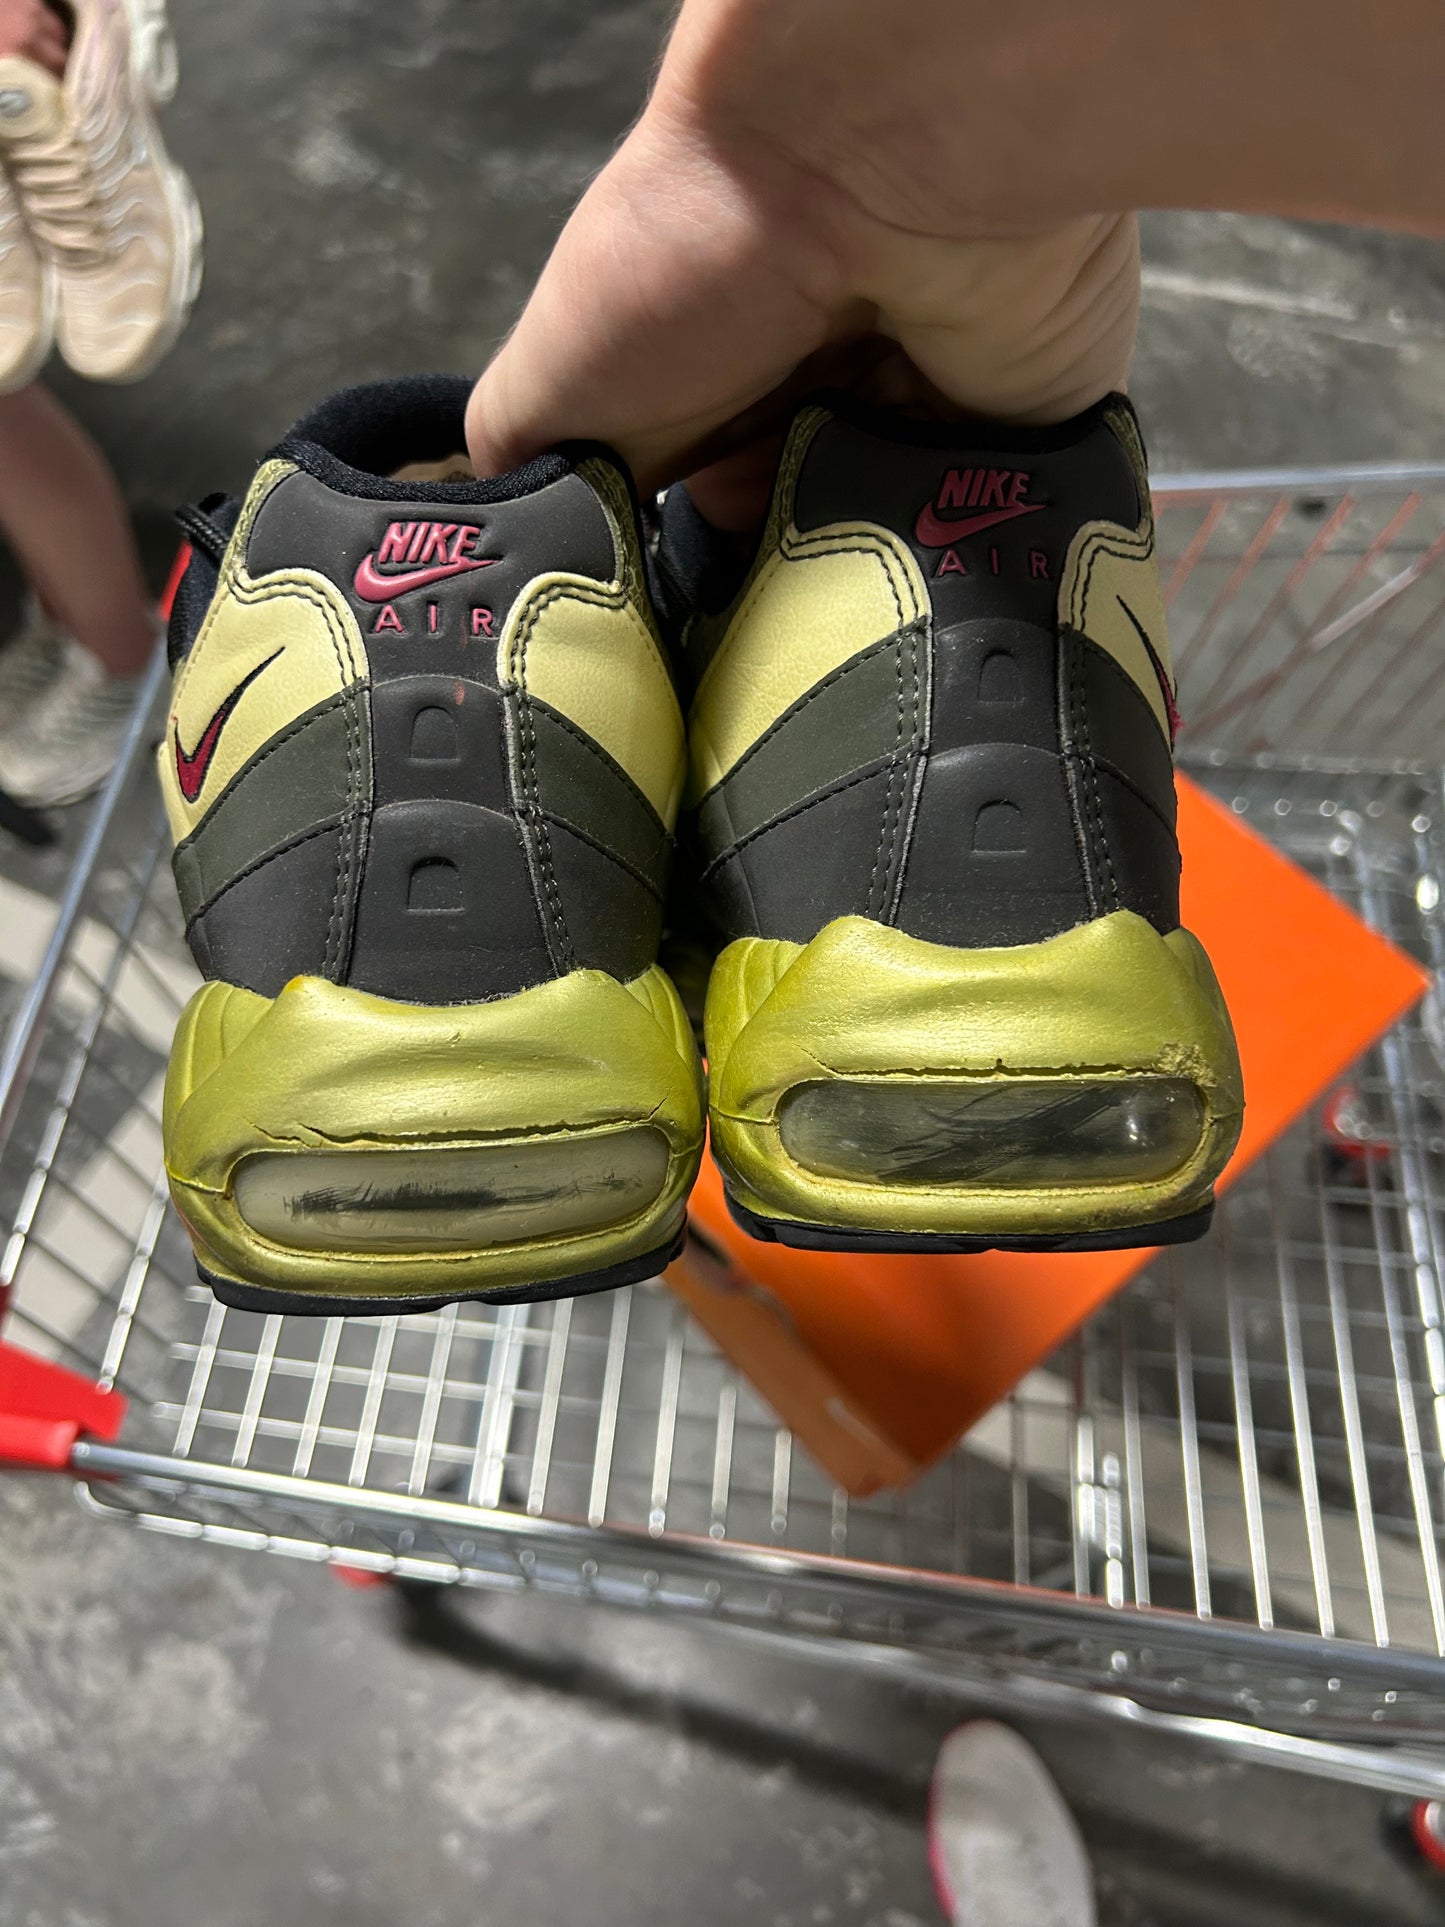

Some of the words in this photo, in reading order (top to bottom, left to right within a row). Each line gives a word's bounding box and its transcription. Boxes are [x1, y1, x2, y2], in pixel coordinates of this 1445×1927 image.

[939, 469, 1030, 507] NIKE
[379, 522, 481, 564] NIKE
[938, 549, 1049, 578] AIR
[375, 605, 493, 637] AIR
